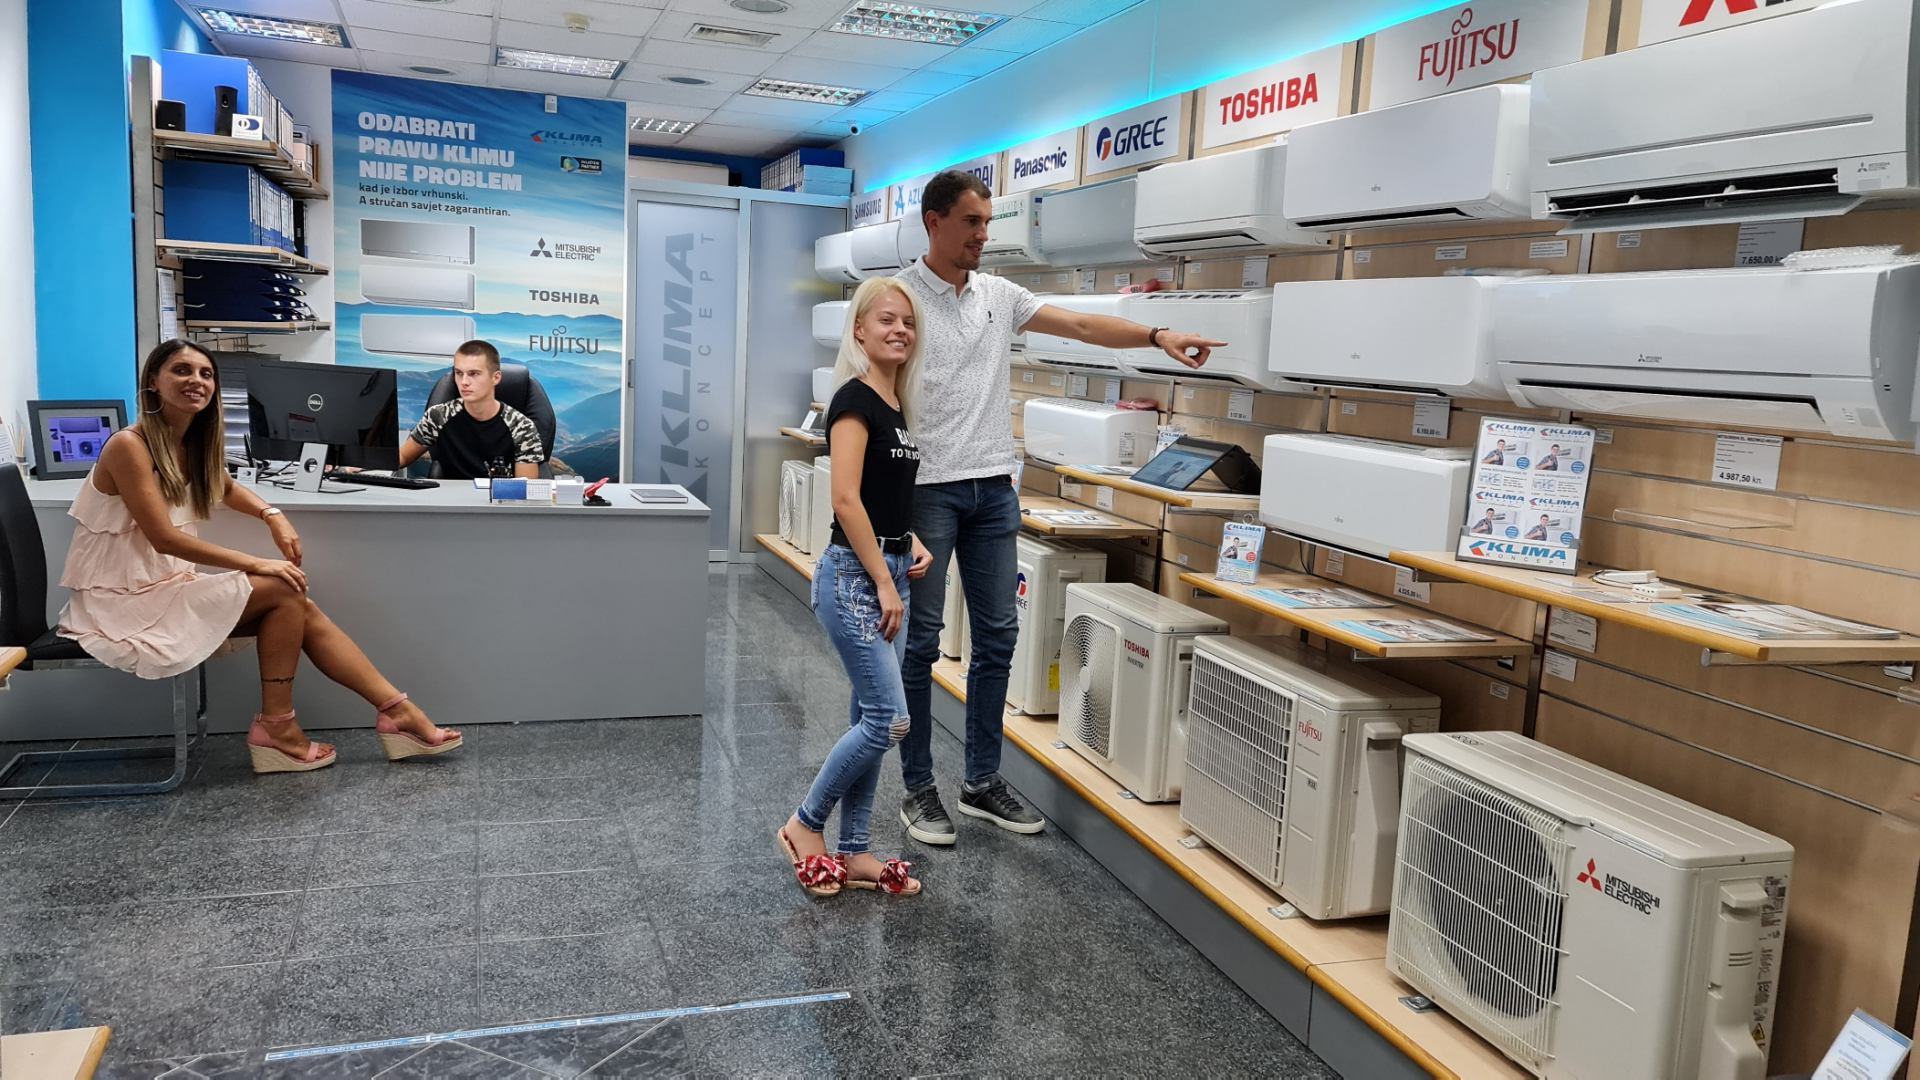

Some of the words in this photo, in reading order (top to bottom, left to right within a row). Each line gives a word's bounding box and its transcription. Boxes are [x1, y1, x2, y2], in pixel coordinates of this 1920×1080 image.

[1417, 8, 1520, 87] FUJITSU
[1219, 72, 1319, 125] TOSHIBA
[358, 111, 476, 141] ODABRATI
[1114, 116, 1168, 156] GREE
[544, 130, 602, 143] KLIMA
[358, 136, 440, 161] PRAVU
[443, 144, 515, 168] KLIMU
[1014, 146, 1068, 179] Panasonic
[359, 160, 408, 182] NIJE
[413, 165, 522, 192] PROBLEM
[359, 183, 378, 193] kad
[380, 185, 391, 195] je
[392, 185, 418, 196] izbor
[421, 188, 469, 201] vrhunski.
[907, 186, 925, 206] AZU
[359, 196, 367, 205] A
[369, 196, 409, 209] stručan
[411, 199, 442, 212] savjet
[444, 203, 511, 217] zagarantiran.
[854, 198, 882, 220] SAMSUNG
[555, 243, 601, 254] MITSUBISHI
[555, 251, 595, 261] ELECTRIC
[529, 289, 600, 305] TOSHIBA
[529, 326, 599, 358] FUJITSU
[1496, 423, 1536, 432] KLIMA
[1549, 428, 1591, 436] KLIMA
[890, 448, 904, 459] TO
[1719, 472, 1751, 483] 4.987,50
[1485, 491, 1525, 502] KLIMA
[1539, 498, 1580, 507] KLIMA
[1485, 553, 1566, 567] KONCEPT
[1486, 542, 1567, 560] KLIMA
[1017, 597, 1028, 610] REE
[1124, 638, 1150, 660] TOSHIBA
[1298, 719, 1323, 742] FUJITSU
[1604, 884, 1651, 915] ELECTRIC
[1605, 873, 1661, 908] MITSUBISHI
